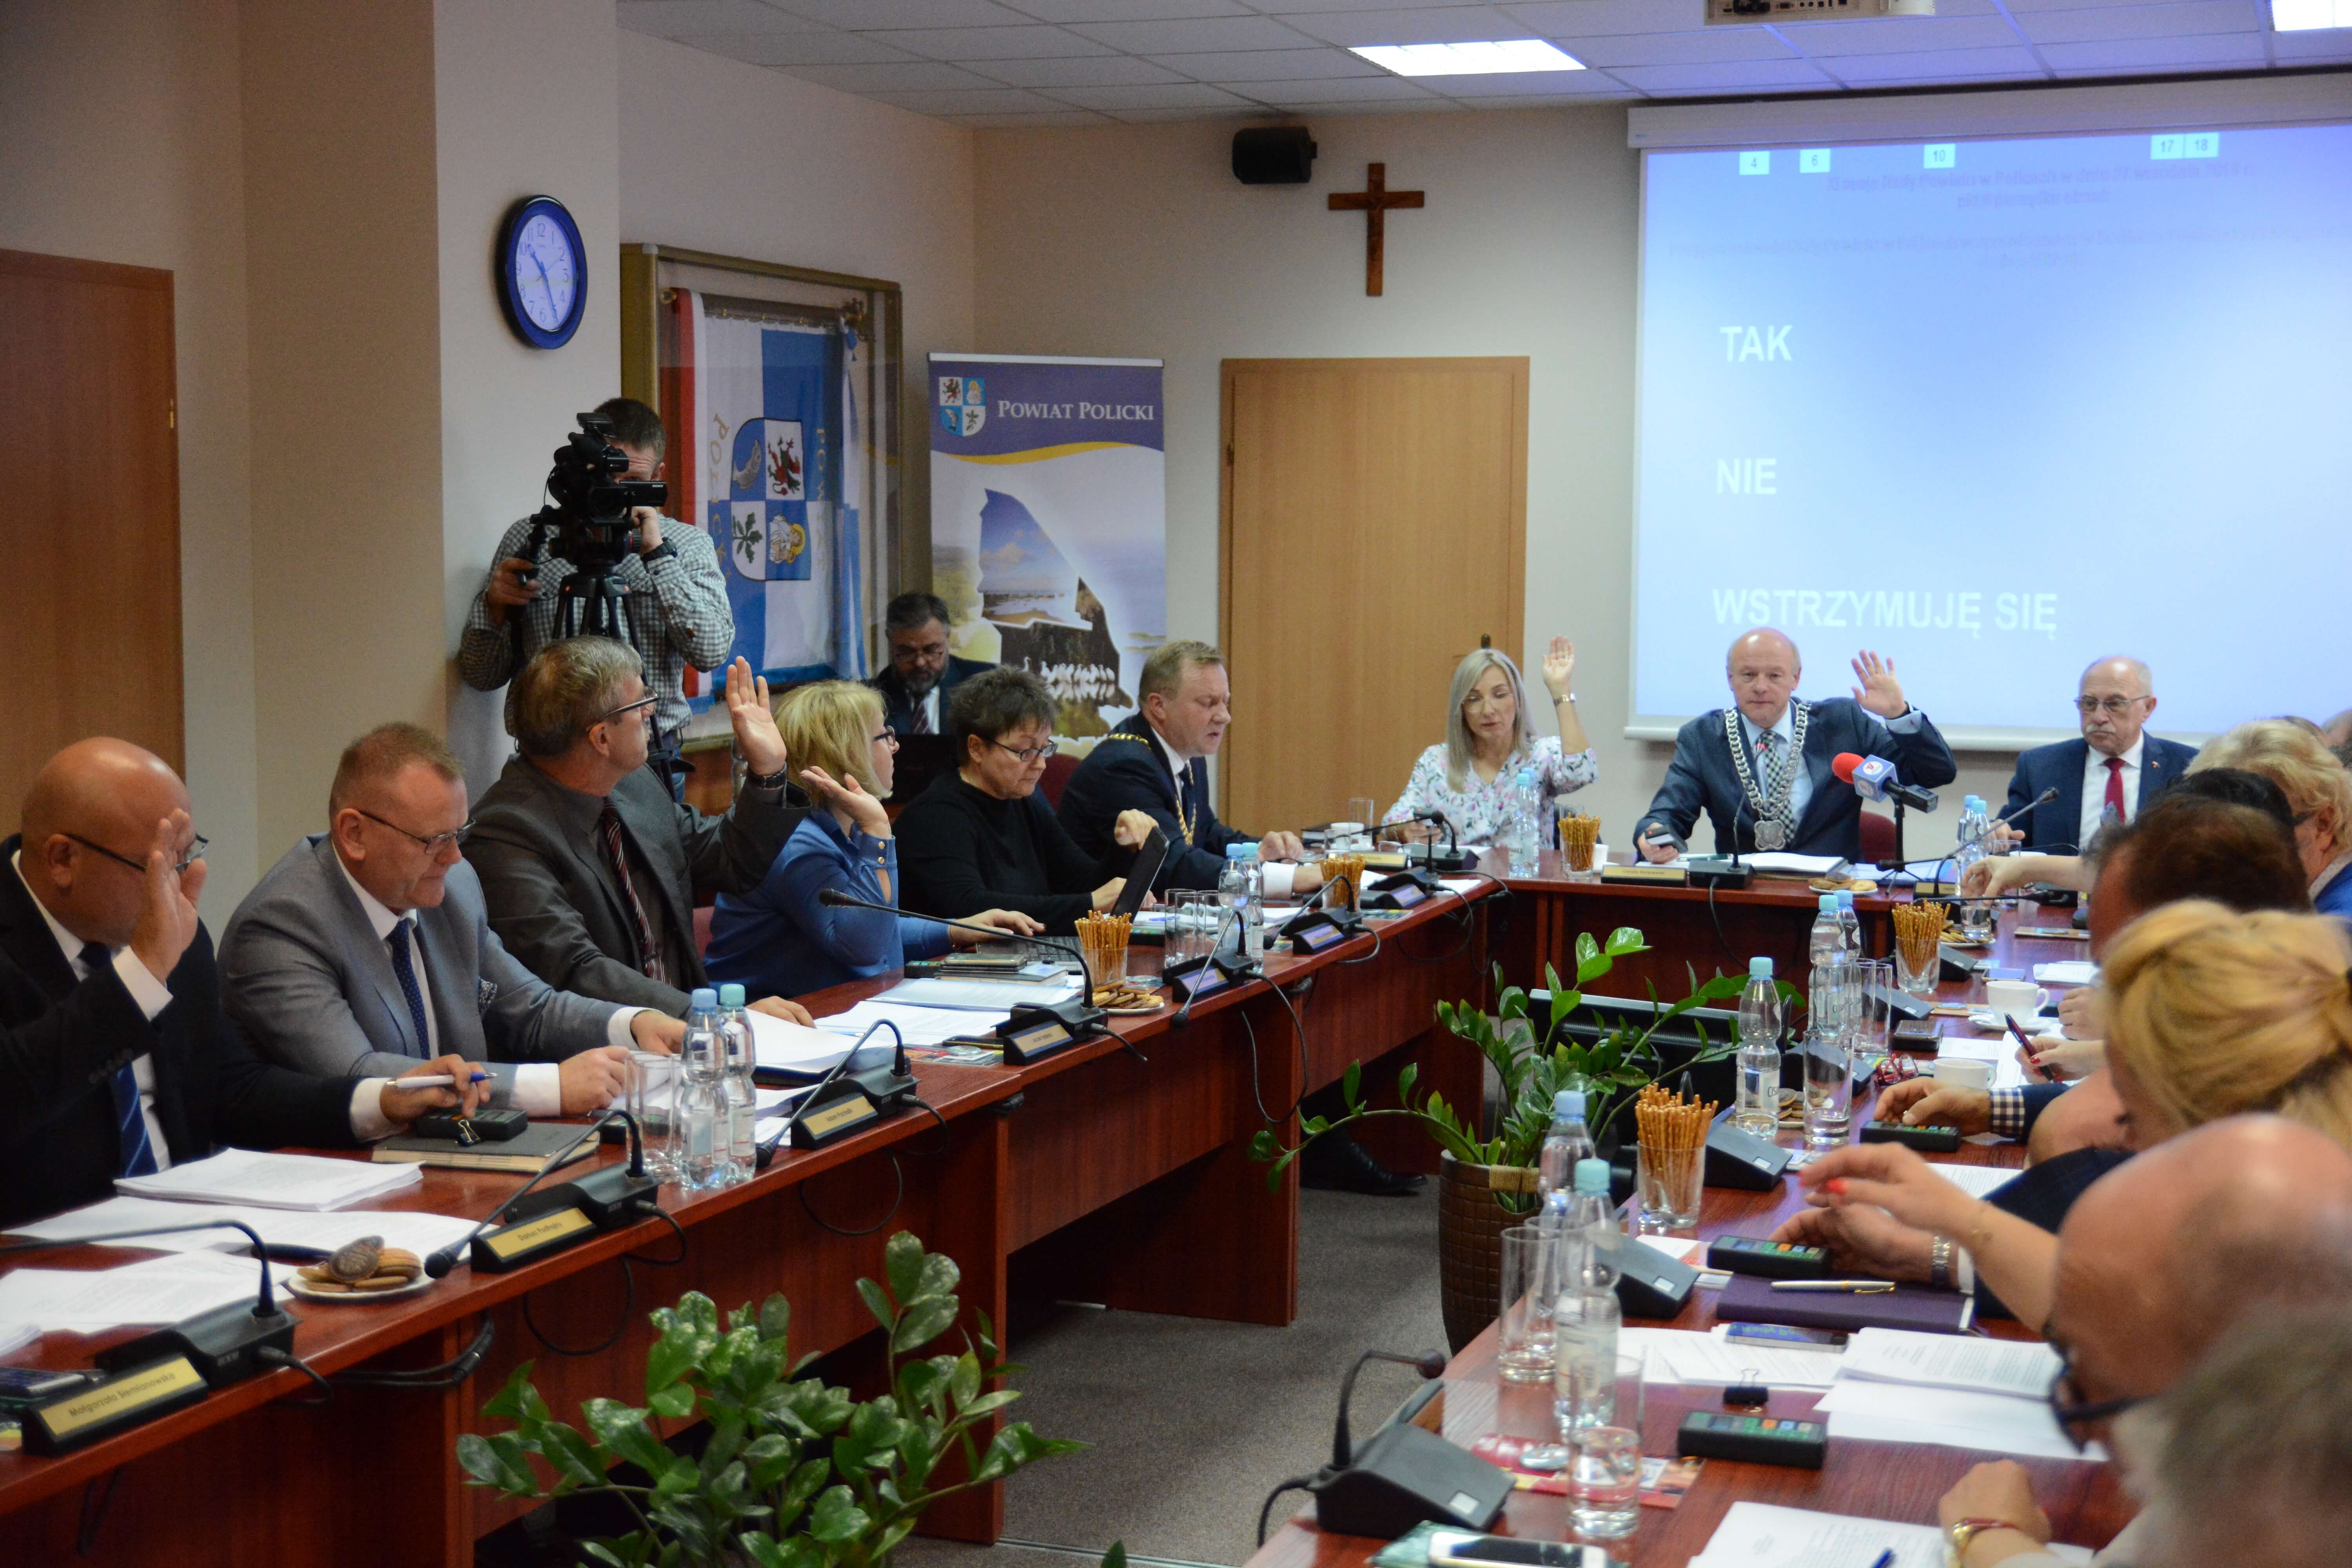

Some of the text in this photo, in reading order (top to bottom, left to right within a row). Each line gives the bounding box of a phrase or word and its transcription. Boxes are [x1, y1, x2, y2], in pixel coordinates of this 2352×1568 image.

[2160, 138, 2208, 153] 17 18
[1750, 157, 1758, 169] 4
[1811, 154, 1818, 167] 6
[1933, 149, 1946, 162] 10
[1720, 325, 1792, 362] TAK
[997, 400, 1154, 421] POWIAT POLICKI
[1717, 458, 1777, 495] NIE
[1713, 589, 2057, 640] WSTRZYMUJĘ SIĘ
